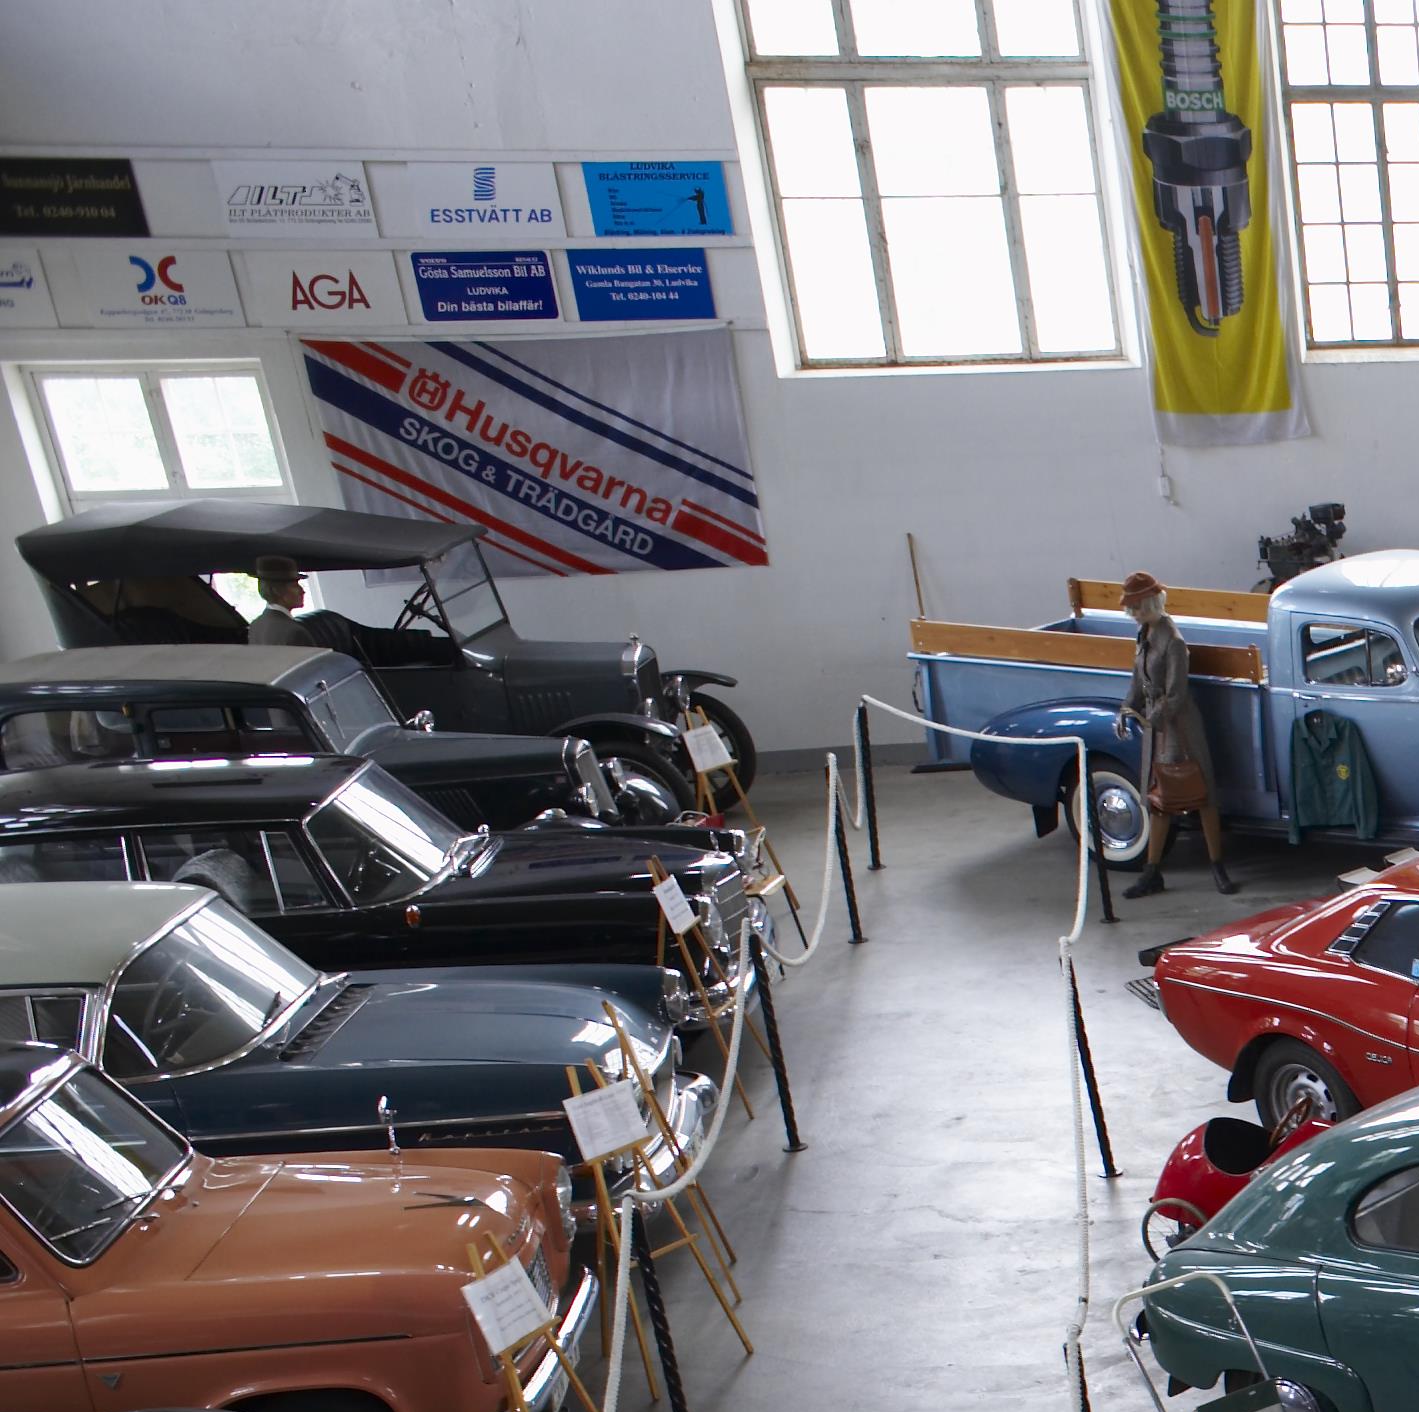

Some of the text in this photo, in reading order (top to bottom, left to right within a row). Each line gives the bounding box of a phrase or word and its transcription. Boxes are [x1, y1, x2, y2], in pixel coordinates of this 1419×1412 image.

[1166, 90, 1224, 111] BOSCH
[430, 205, 553, 224] ESSTVÄTT AB
[530, 265, 546, 277] AB
[291, 270, 371, 311] AGA
[437, 301, 458, 312] Din
[461, 300, 495, 312] bästa
[445, 389, 675, 527] Husqvarna
[399, 417, 655, 556] SKOG & TRÄDGÅRD
